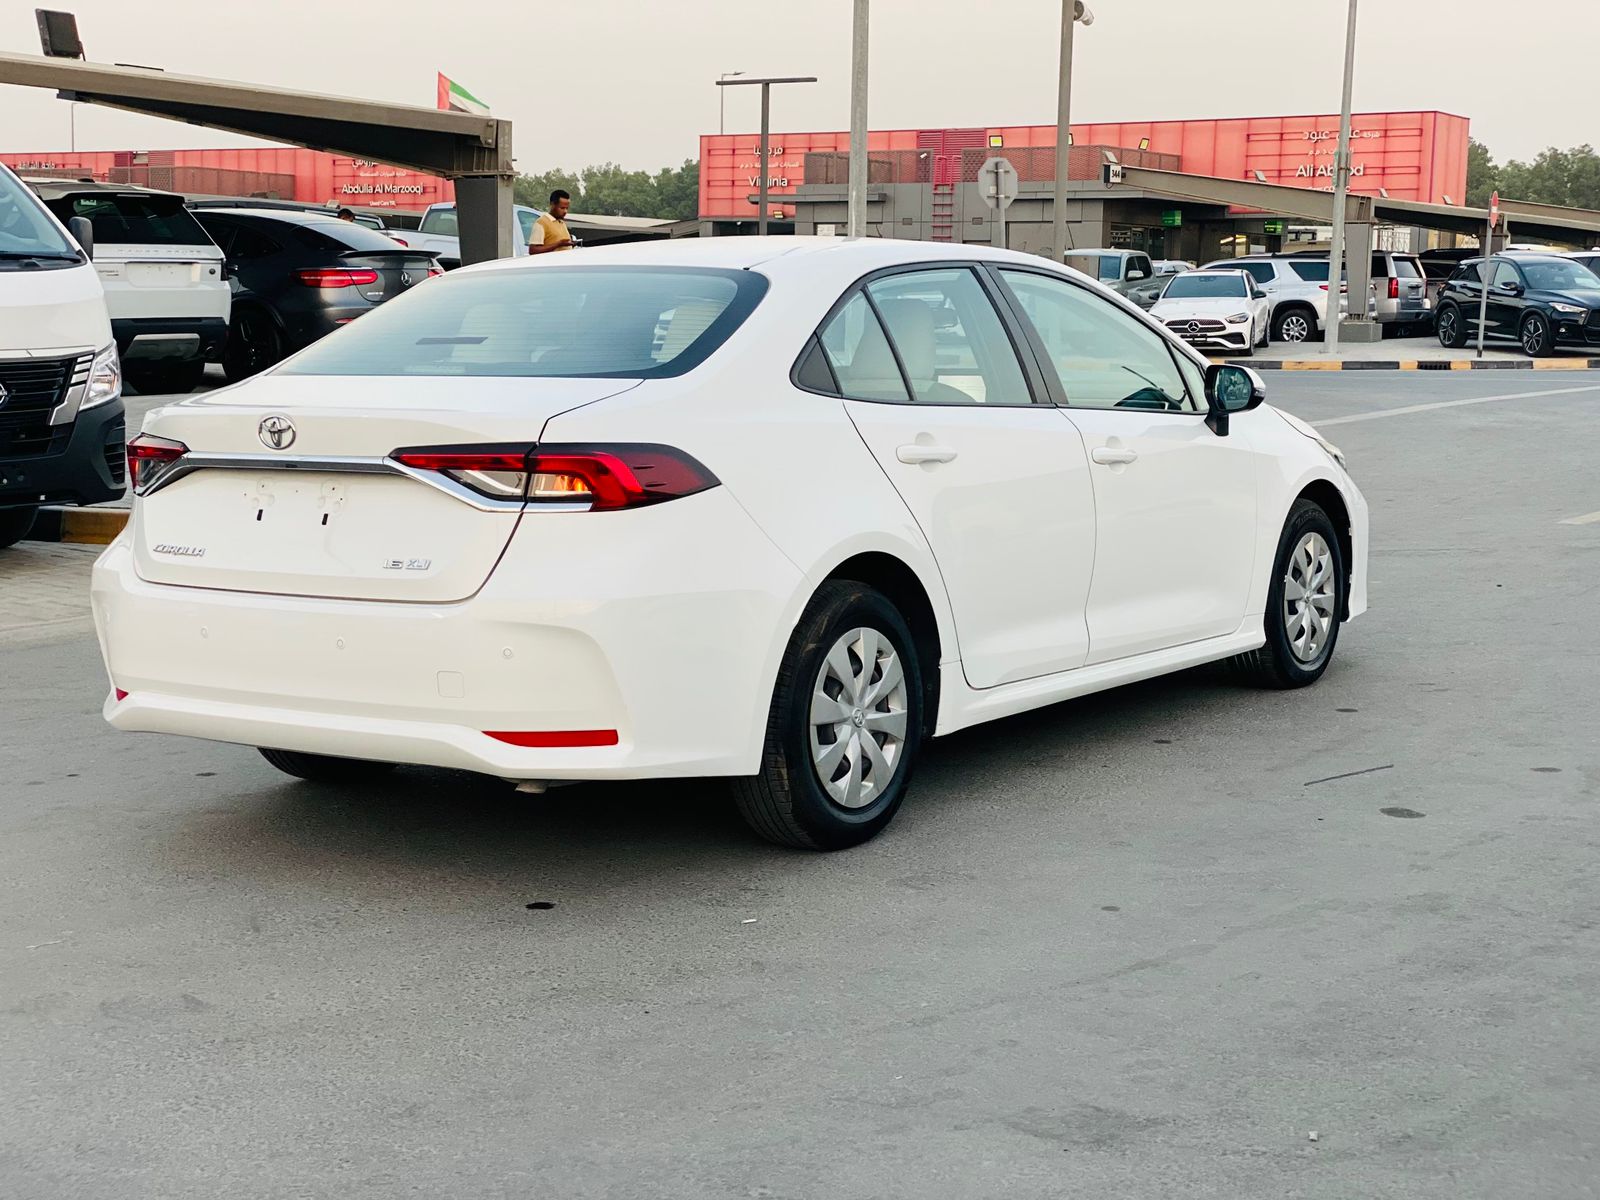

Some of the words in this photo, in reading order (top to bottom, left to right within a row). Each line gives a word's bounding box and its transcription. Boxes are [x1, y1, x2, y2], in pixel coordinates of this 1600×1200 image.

[1296, 164, 1314, 177] Ali
[342, 183, 373, 194] Abdulla
[374, 183, 383, 194] Al
[385, 182, 424, 195] Marzooqi
[153, 543, 206, 557] COROLLA
